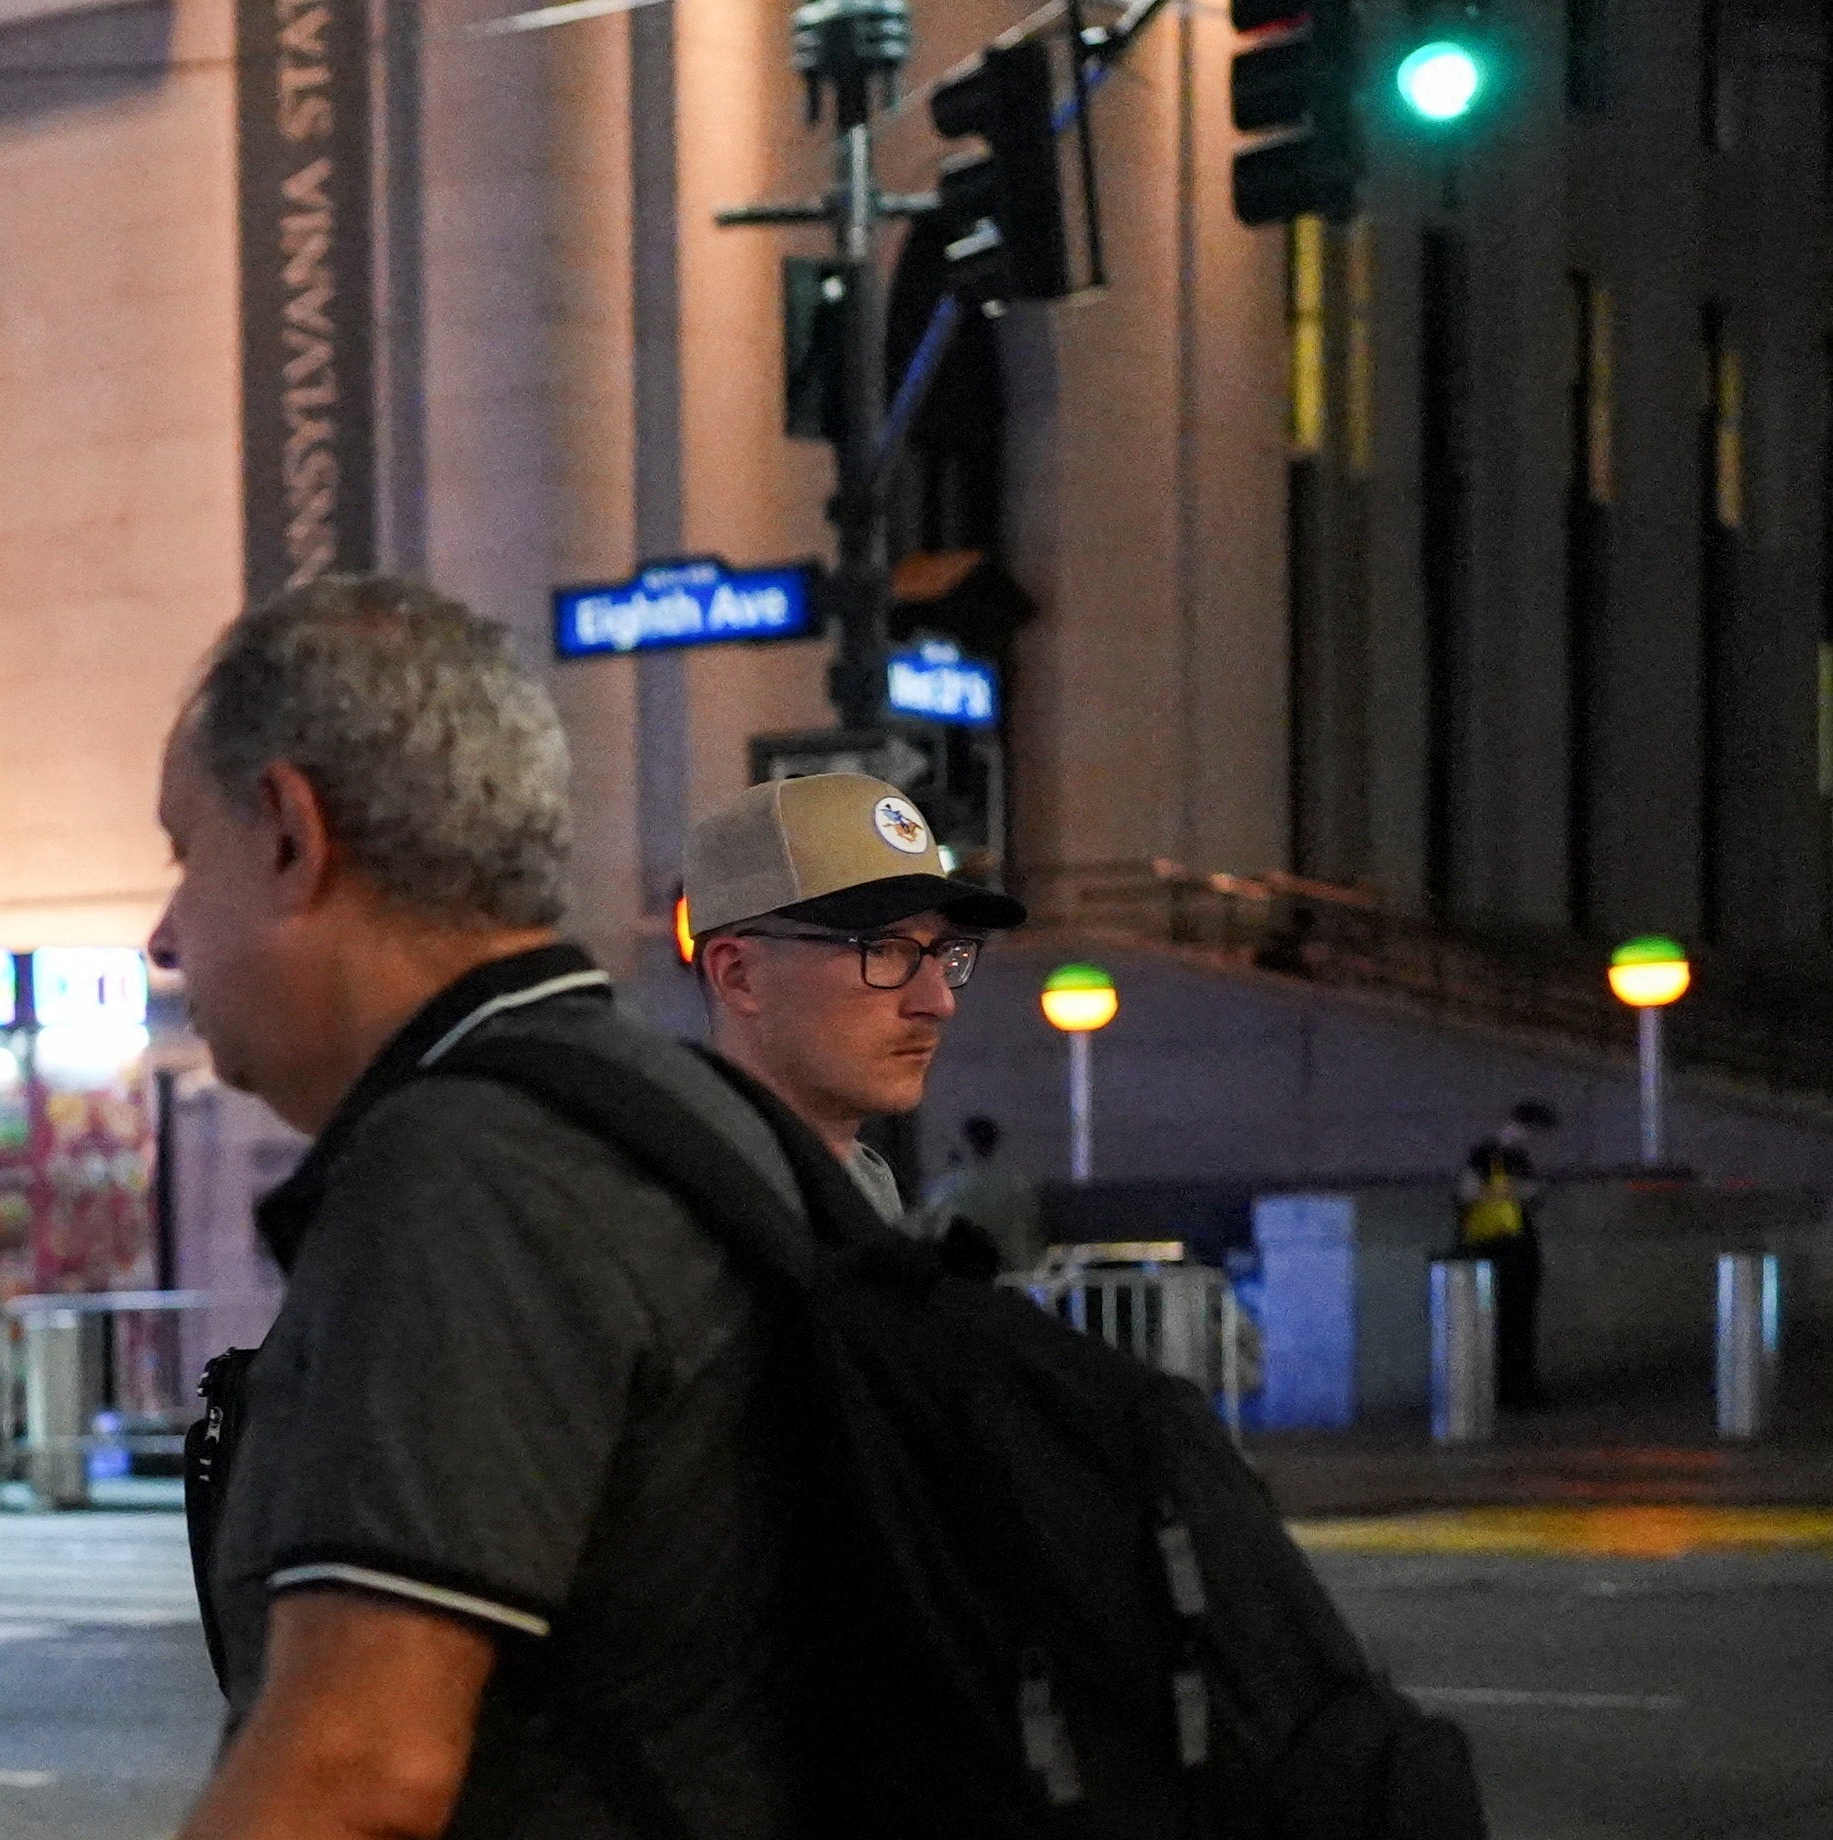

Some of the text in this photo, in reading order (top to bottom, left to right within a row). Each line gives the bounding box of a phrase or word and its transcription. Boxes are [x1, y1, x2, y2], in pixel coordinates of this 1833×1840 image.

[277, 0, 336, 594] NNSYLVANIA STA
[574, 584, 790, 651] Eighth Ave
